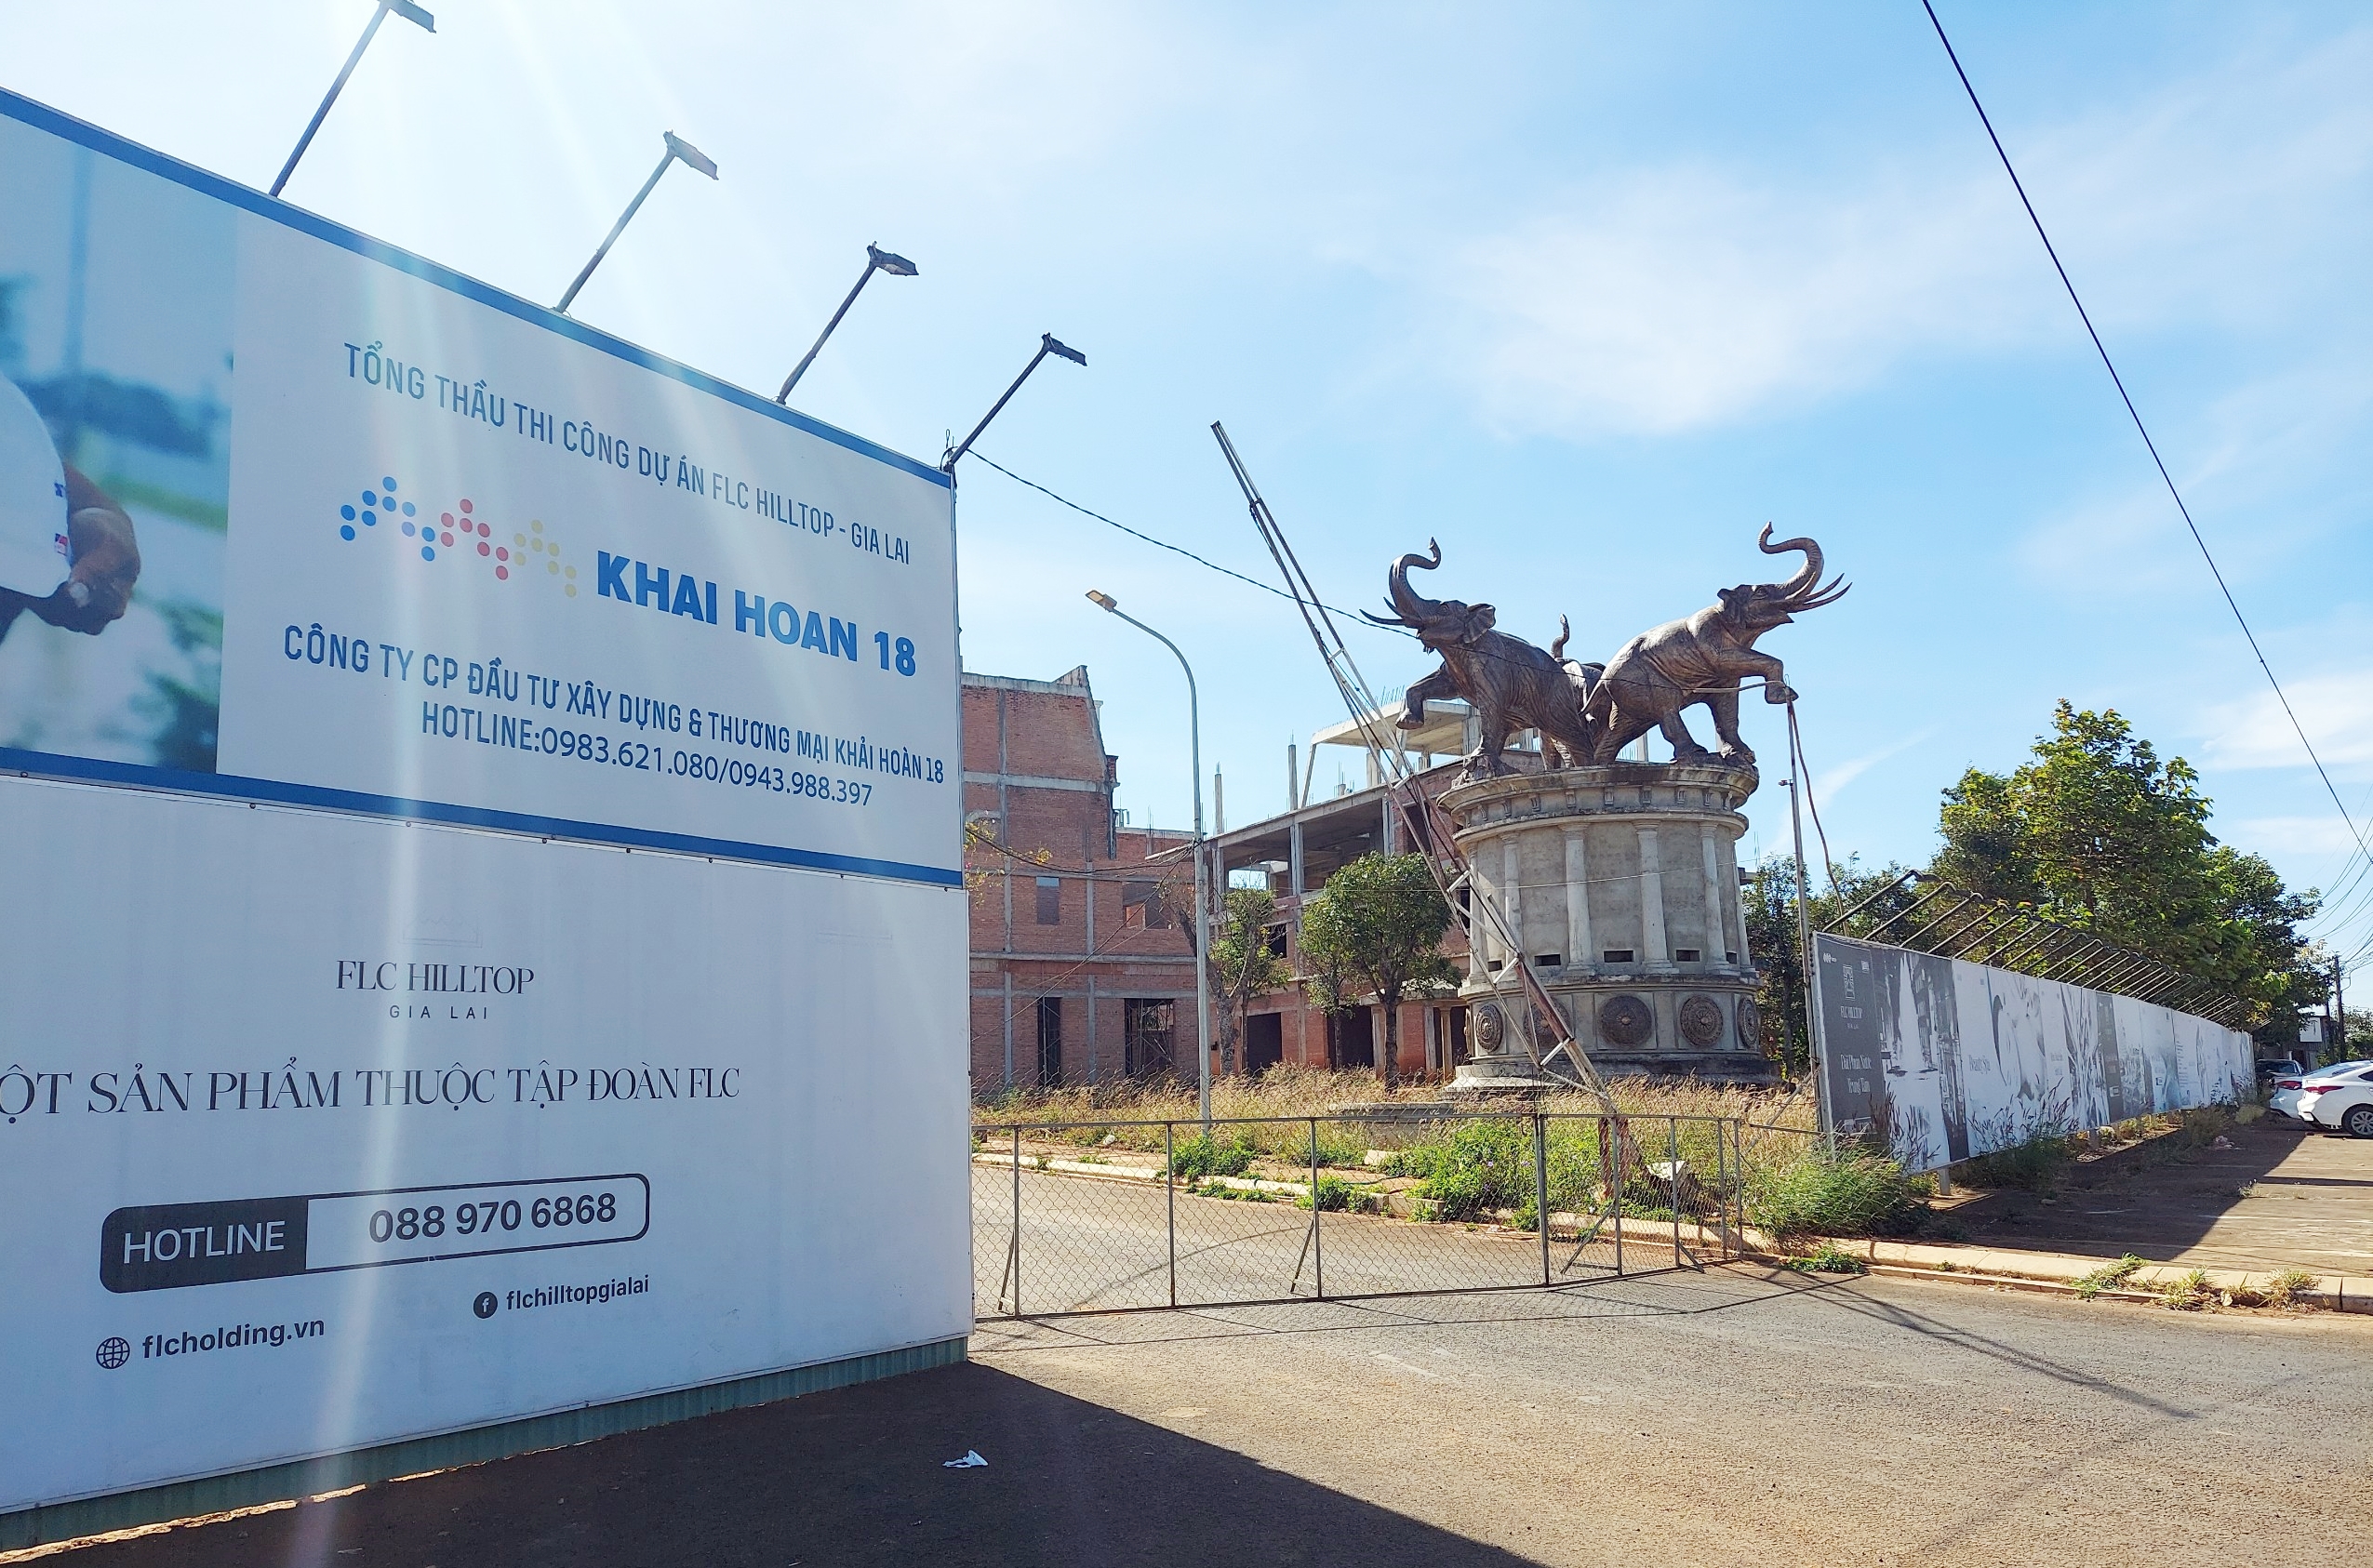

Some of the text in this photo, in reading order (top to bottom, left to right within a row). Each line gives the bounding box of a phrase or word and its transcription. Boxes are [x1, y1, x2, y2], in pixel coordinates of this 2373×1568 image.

[344, 340, 424, 400] TỔNG
[434, 379, 505, 427] THẦU
[513, 402, 553, 445] THI
[564, 420, 629, 469] CÔNG
[638, 446, 670, 486] DỰ
[676, 454, 704, 496] ÁN
[713, 472, 749, 510] FLC
[756, 487, 834, 537] HILLTOP
[851, 522, 880, 555] GIA
[885, 533, 910, 565] LAI
[597, 550, 916, 677] KHAI HOAN 18
[285, 622, 944, 784] CÔNG TY CP ĐẦU TƯ XÂY DỰNG & THƯƠNG MẠI KHẢI HOÀN 18
[336, 960, 535, 994] FLC HILLTOP
[389, 1005, 487, 1019] GIA LAI
[88, 1062, 193, 1113] SẢN
[207, 1056, 342, 1110] PHẨM
[355, 1061, 495, 1111] THUỘC
[507, 1059, 579, 1109] TẬP
[586, 1061, 679, 1100] ĐOÀN
[688, 1068, 740, 1098] FLC
[123, 1192, 617, 1264] HOTLINE 088 970 6868
[506, 1274, 649, 1310] flchilltopgialai
[142, 1319, 325, 1359] flcholding.vn
